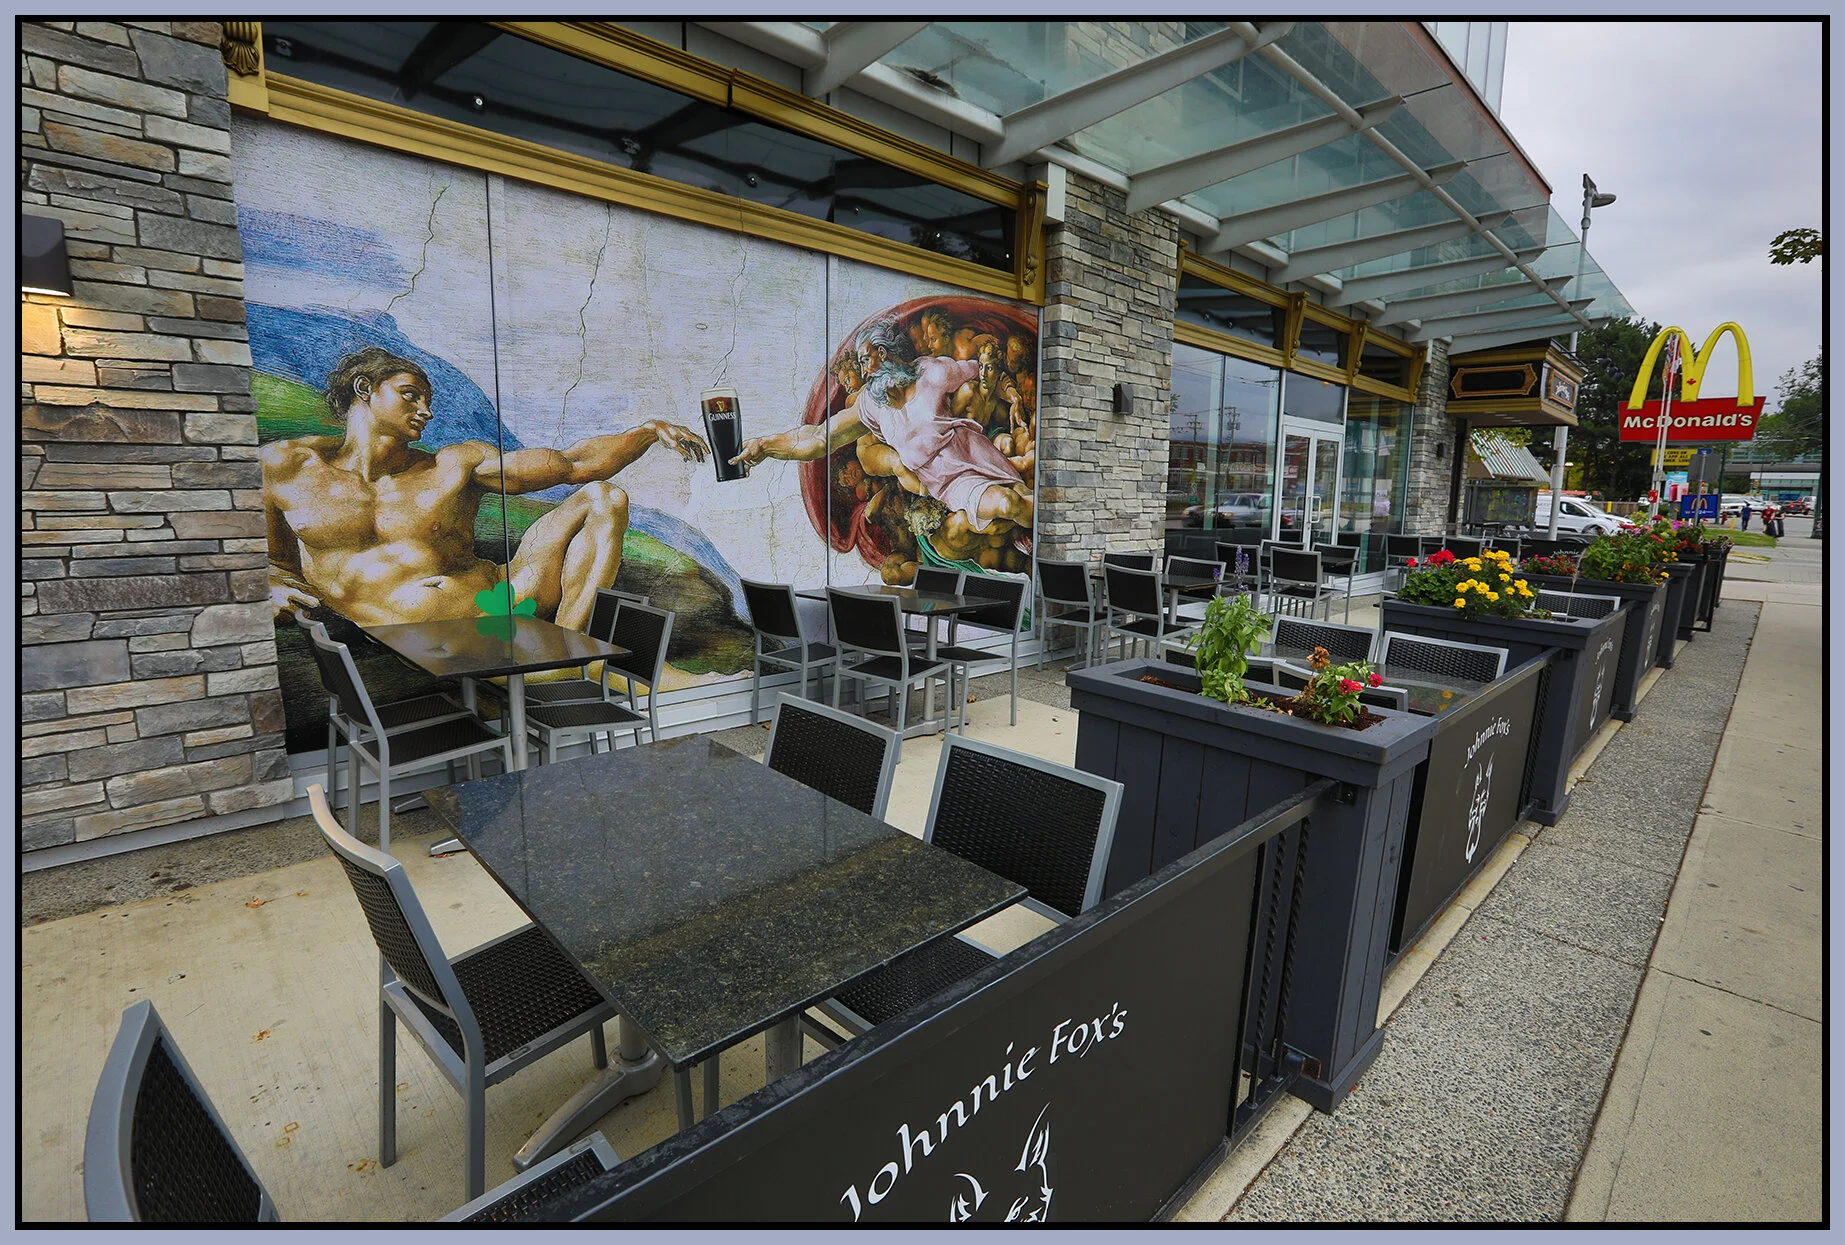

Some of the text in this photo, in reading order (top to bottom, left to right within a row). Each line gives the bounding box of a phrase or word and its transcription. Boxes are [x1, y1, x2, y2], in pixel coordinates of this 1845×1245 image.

[708, 411, 737, 421] GUINNESS
[1623, 413, 1753, 429] McDonald's
[1464, 716, 1496, 769] Johnnie
[839, 1002, 1128, 1222] Johnnie Fox's
